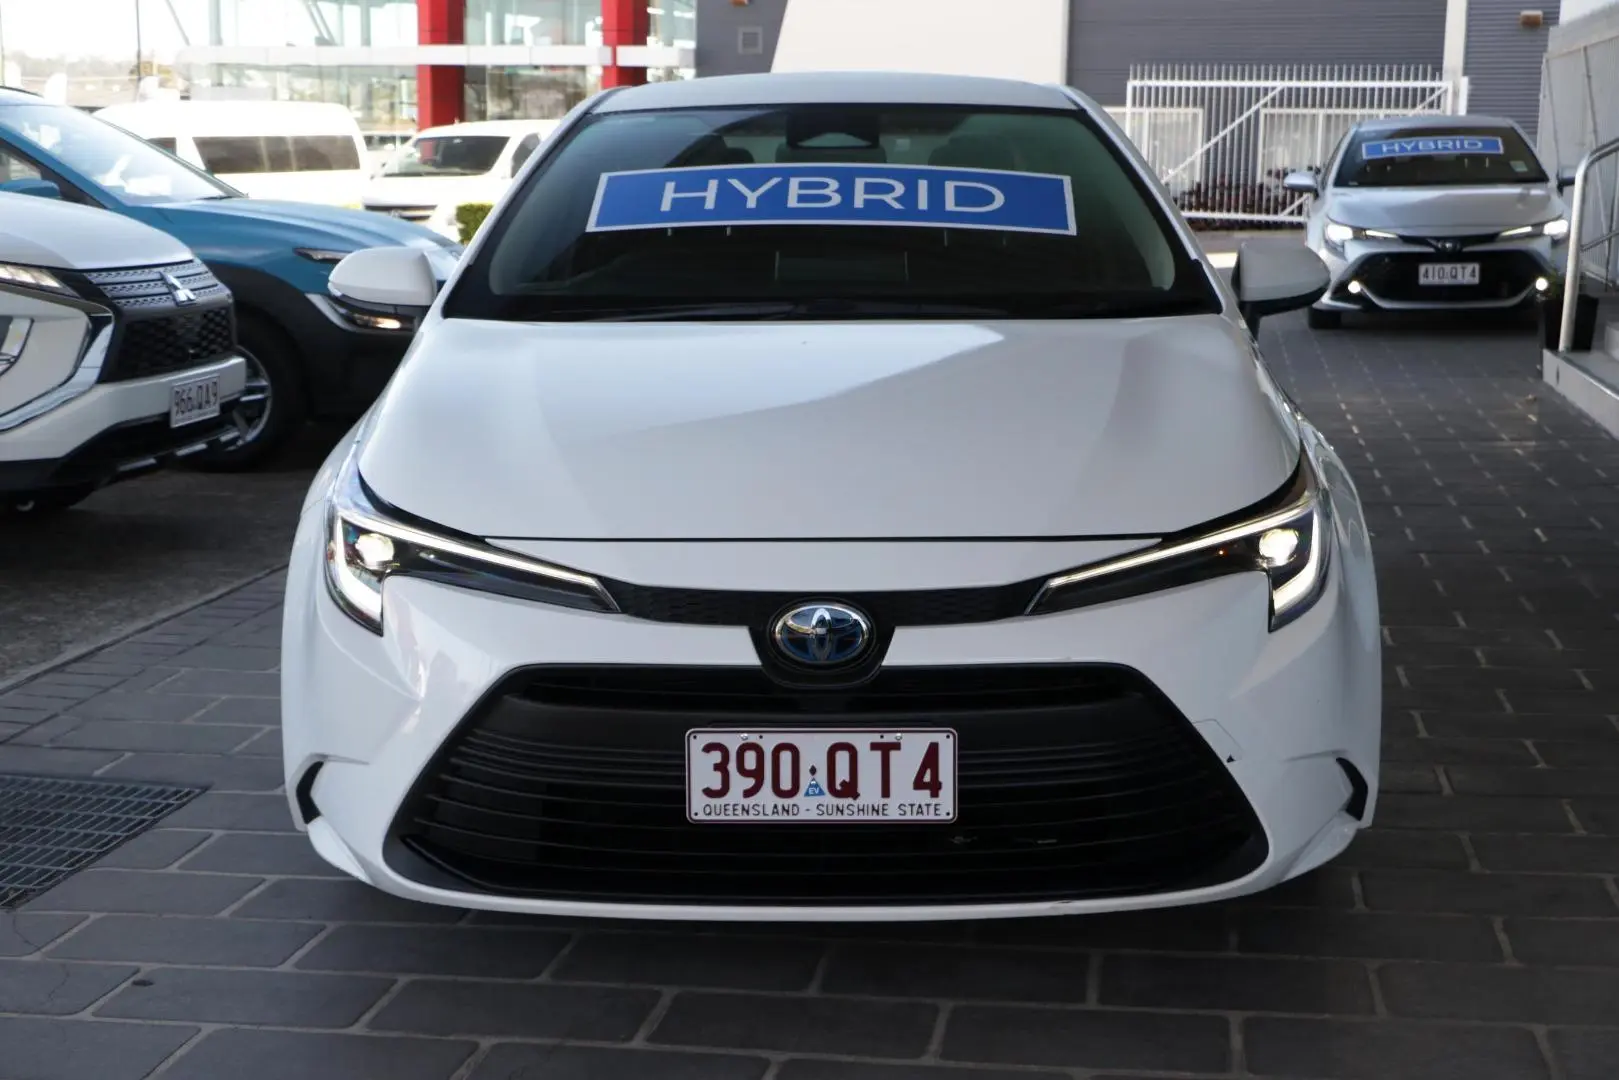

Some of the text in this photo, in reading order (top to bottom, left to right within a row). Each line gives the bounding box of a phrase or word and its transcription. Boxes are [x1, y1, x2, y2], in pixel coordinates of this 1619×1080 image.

[1381, 139, 1483, 153] HYBRID
[659, 176, 1006, 213] HYBRID
[701, 741, 943, 801] 390 QT4
[808, 786, 820, 796] EV
[702, 803, 800, 817] QUEENSLAND
[816, 803, 890, 817] SUNSHINE
[897, 803, 941, 817] STATE
